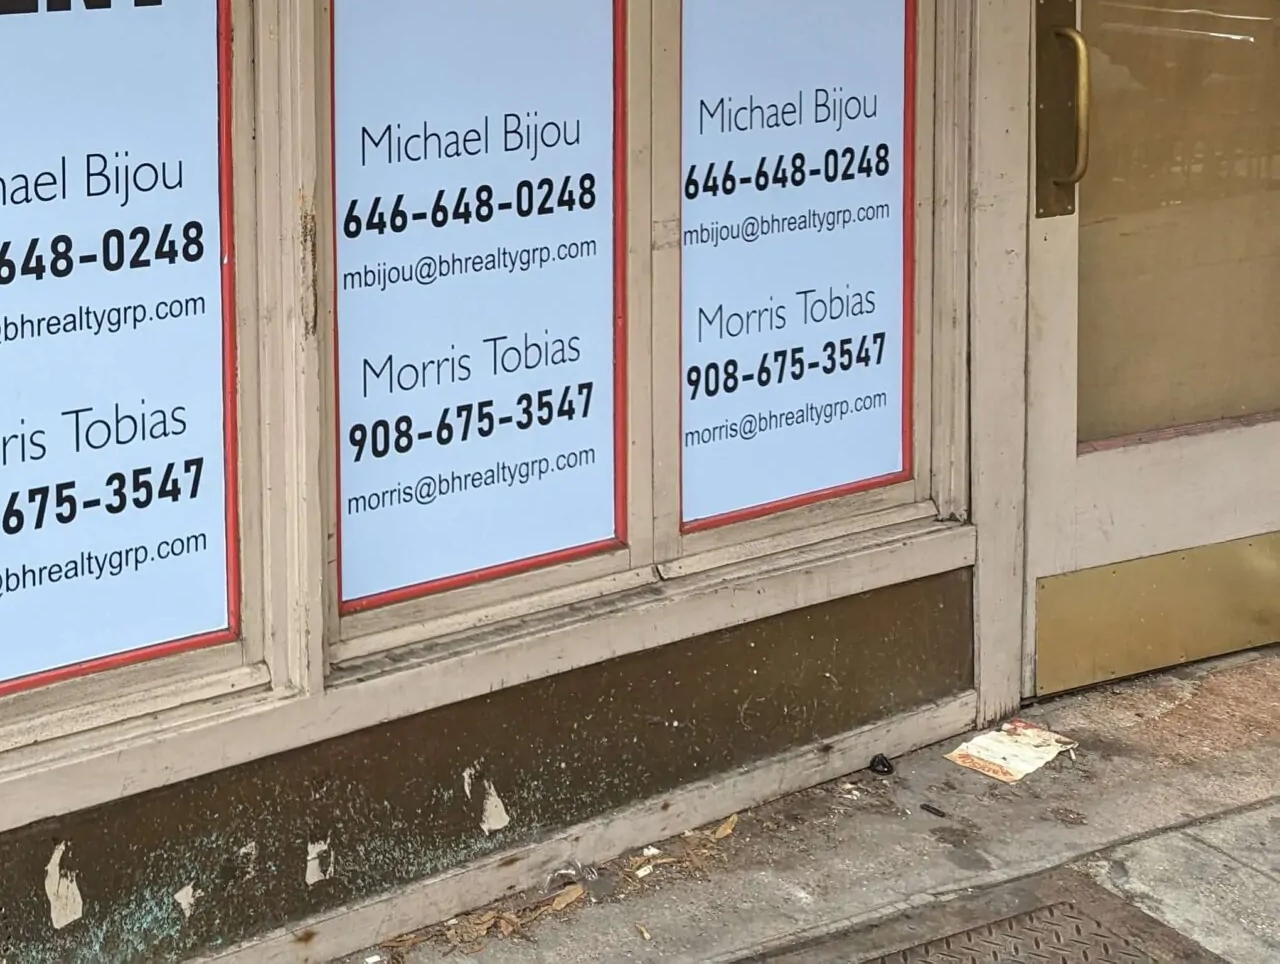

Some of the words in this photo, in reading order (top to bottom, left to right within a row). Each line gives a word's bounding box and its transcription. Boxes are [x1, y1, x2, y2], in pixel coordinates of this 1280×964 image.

[362, 116, 488, 166] Michael
[504, 111, 580, 161] Bijou
[700, 90, 802, 135] Michael
[814, 87, 877, 132] Bijou
[86, 151, 182, 207] Bijou
[684, 143, 889, 200] 646-648-0248
[343, 173, 596, 239] 646-648-0248
[683, 204, 889, 247] mbijou@bhrealtygrp.com
[343, 240, 596, 291] mbijou@bhrealtygrp.com
[698, 296, 786, 343] Morris
[795, 284, 875, 324] Tobias
[363, 344, 471, 398] Morris
[482, 329, 580, 376] Tobias
[686, 332, 886, 400] 908-675-3547
[61, 398, 186, 452] Tobias
[349, 381, 593, 463] 908-675-3547
[684, 392, 886, 447] morris@bhrealtygrp.com
[347, 448, 595, 515] morris@bhrealtygrp.com
